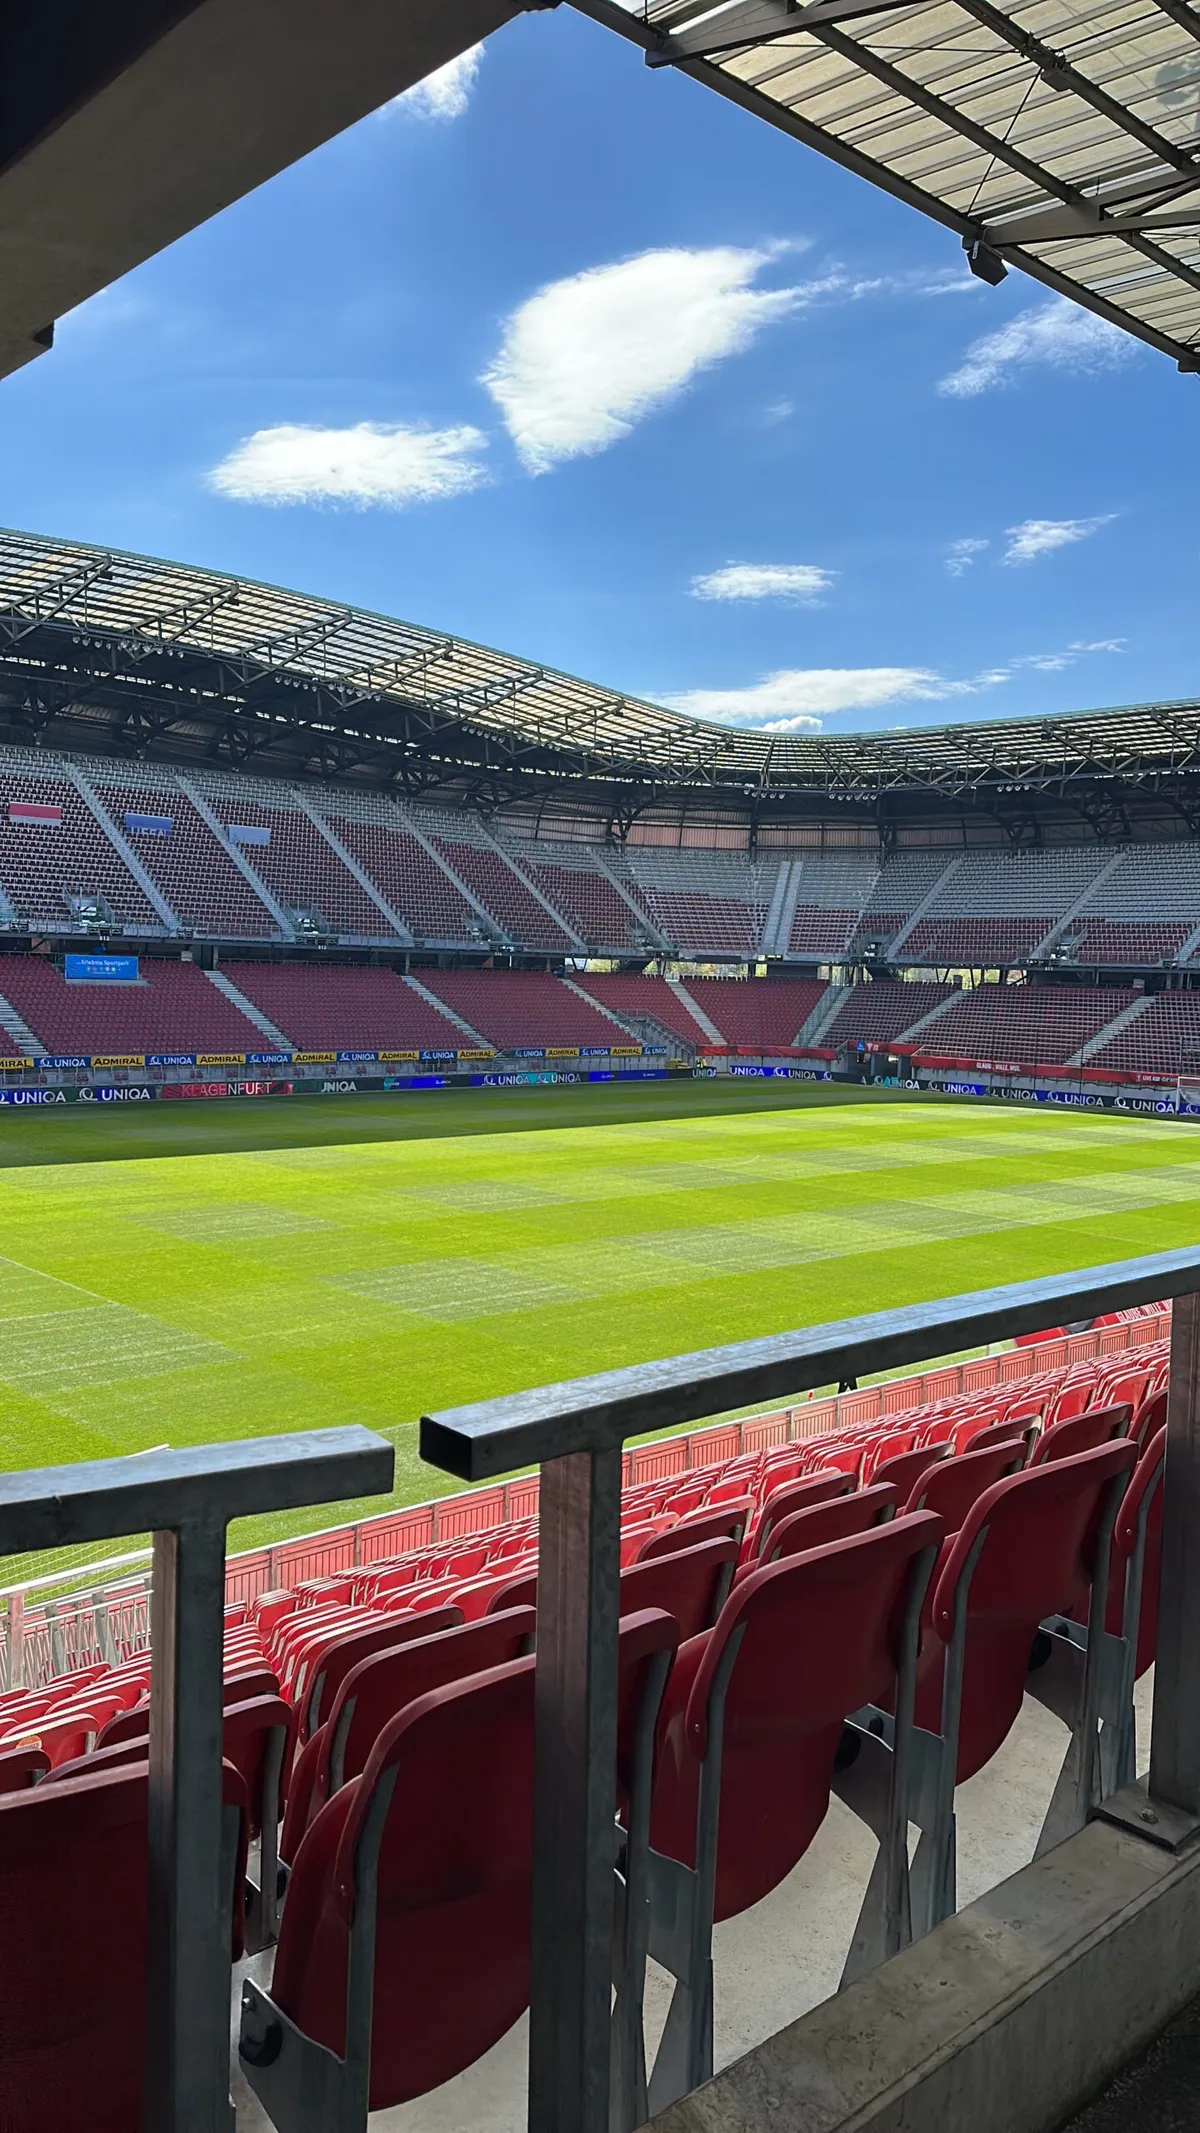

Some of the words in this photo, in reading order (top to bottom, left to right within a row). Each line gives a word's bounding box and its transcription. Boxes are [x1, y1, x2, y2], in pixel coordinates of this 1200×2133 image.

[381, 1051, 417, 1059] ADMIRAL
[432, 1051, 454, 1059] UNIQA
[460, 1050, 493, 1058] ADMIRAL
[523, 1049, 543, 1057] UNIQA
[612, 1047, 641, 1055] ADMIRAL
[94, 1057, 143, 1065] ADMIRAL
[164, 1056, 192, 1065] UNIQA
[200, 1055, 244, 1063] ADMIRAL
[262, 1054, 292, 1063] UNIQA
[295, 1053, 335, 1061] ADMIRAL
[55, 1058, 86, 1067] UNIQA
[730, 1067, 765, 1077] UNIQA
[788, 1070, 817, 1080] UNIQA
[498, 1075, 530, 1085] UNIQA
[552, 1073, 580, 1083] UNIQA
[182, 1082, 272, 1096] KLAGENFURT
[942, 1083, 977, 1095] UNIQA
[14, 1090, 66, 1104] UNIQA
[102, 1088, 151, 1101] UNIQA
[1001, 1088, 1039, 1101] UNIQA
[1064, 1094, 1104, 1107] UNIQA
[1132, 1100, 1175, 1113] UNIQA
